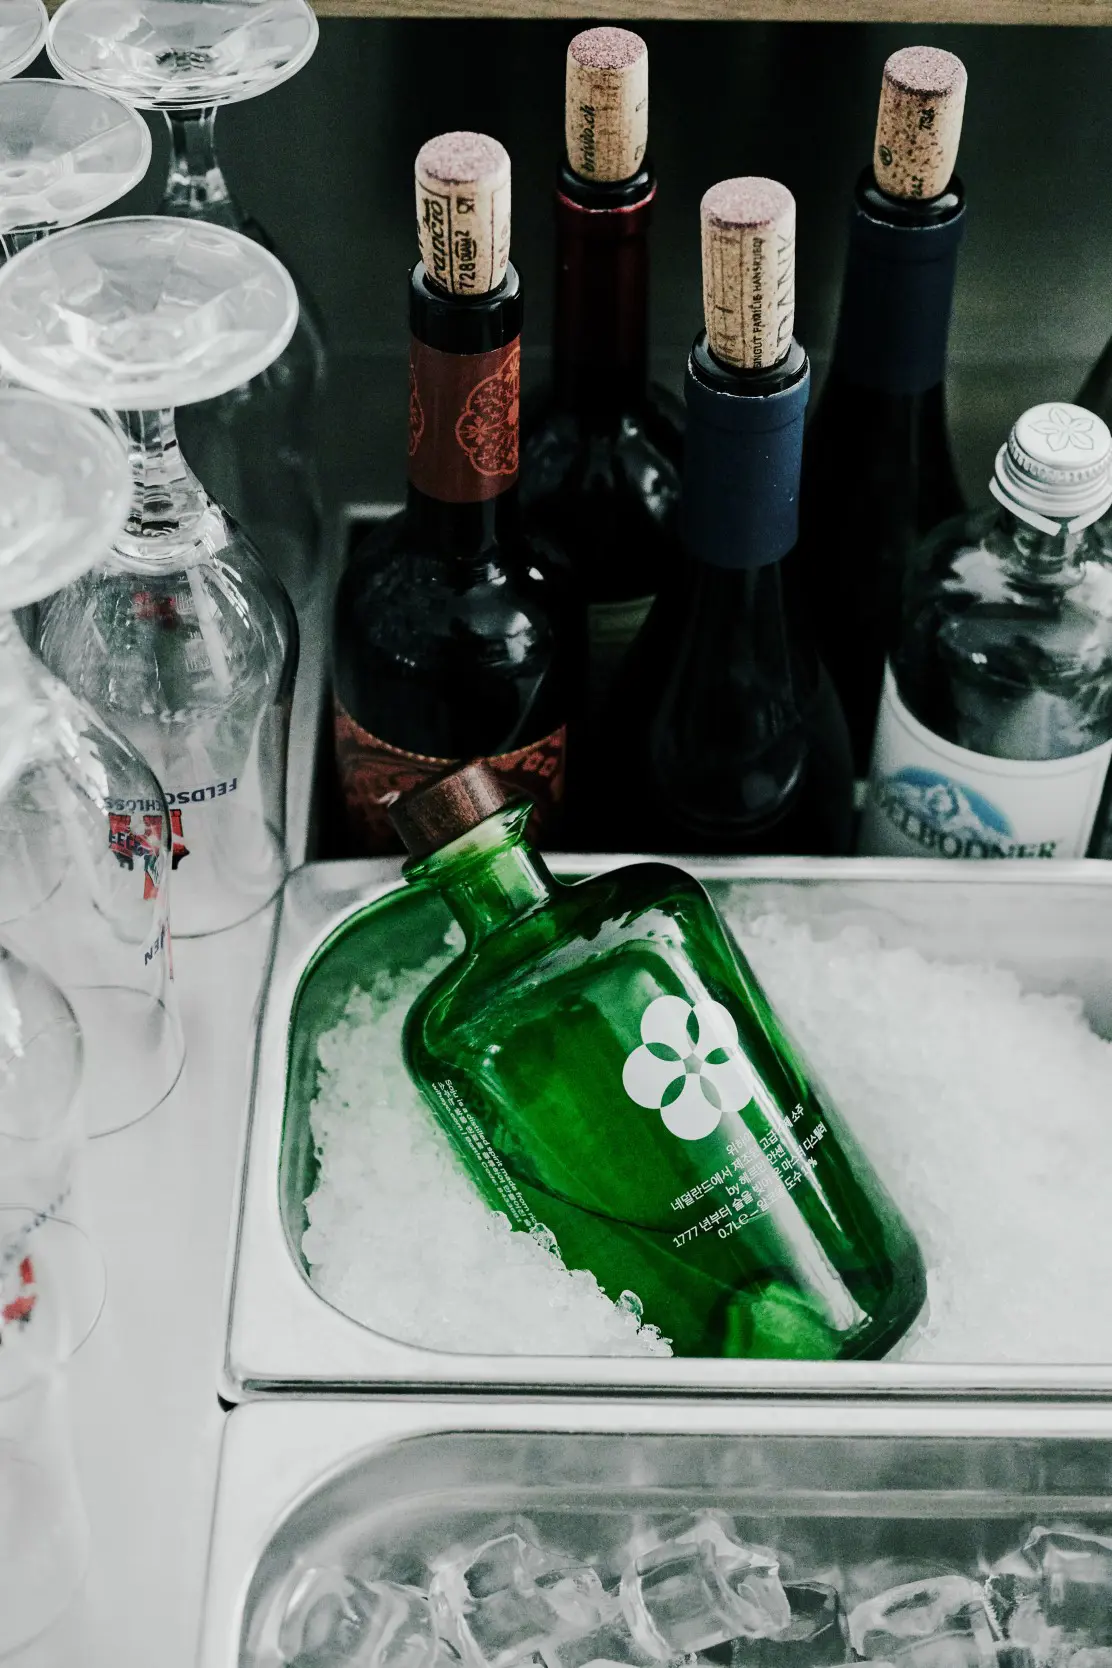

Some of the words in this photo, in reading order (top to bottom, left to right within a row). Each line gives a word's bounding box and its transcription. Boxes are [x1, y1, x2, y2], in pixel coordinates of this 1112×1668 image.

[445, 1079, 458, 1098] Soju
[467, 1114, 490, 1145] distilled
[487, 1146, 503, 1167] spirit
[500, 1168, 517, 1191] made
[515, 1192, 530, 1211] from
[670, 1165, 733, 1211] 네덜란드에서
[760, 1130, 779, 1151] 고급
[791, 1103, 804, 1123] 소주
[725, 1182, 740, 1196] by
[767, 1144, 786, 1165] 얀센
[784, 1170, 802, 1191] 도수
[672, 1225, 698, 1248] 1777
[699, 1204, 733, 1232] 년부터
[732, 1190, 754, 1212] 술을
